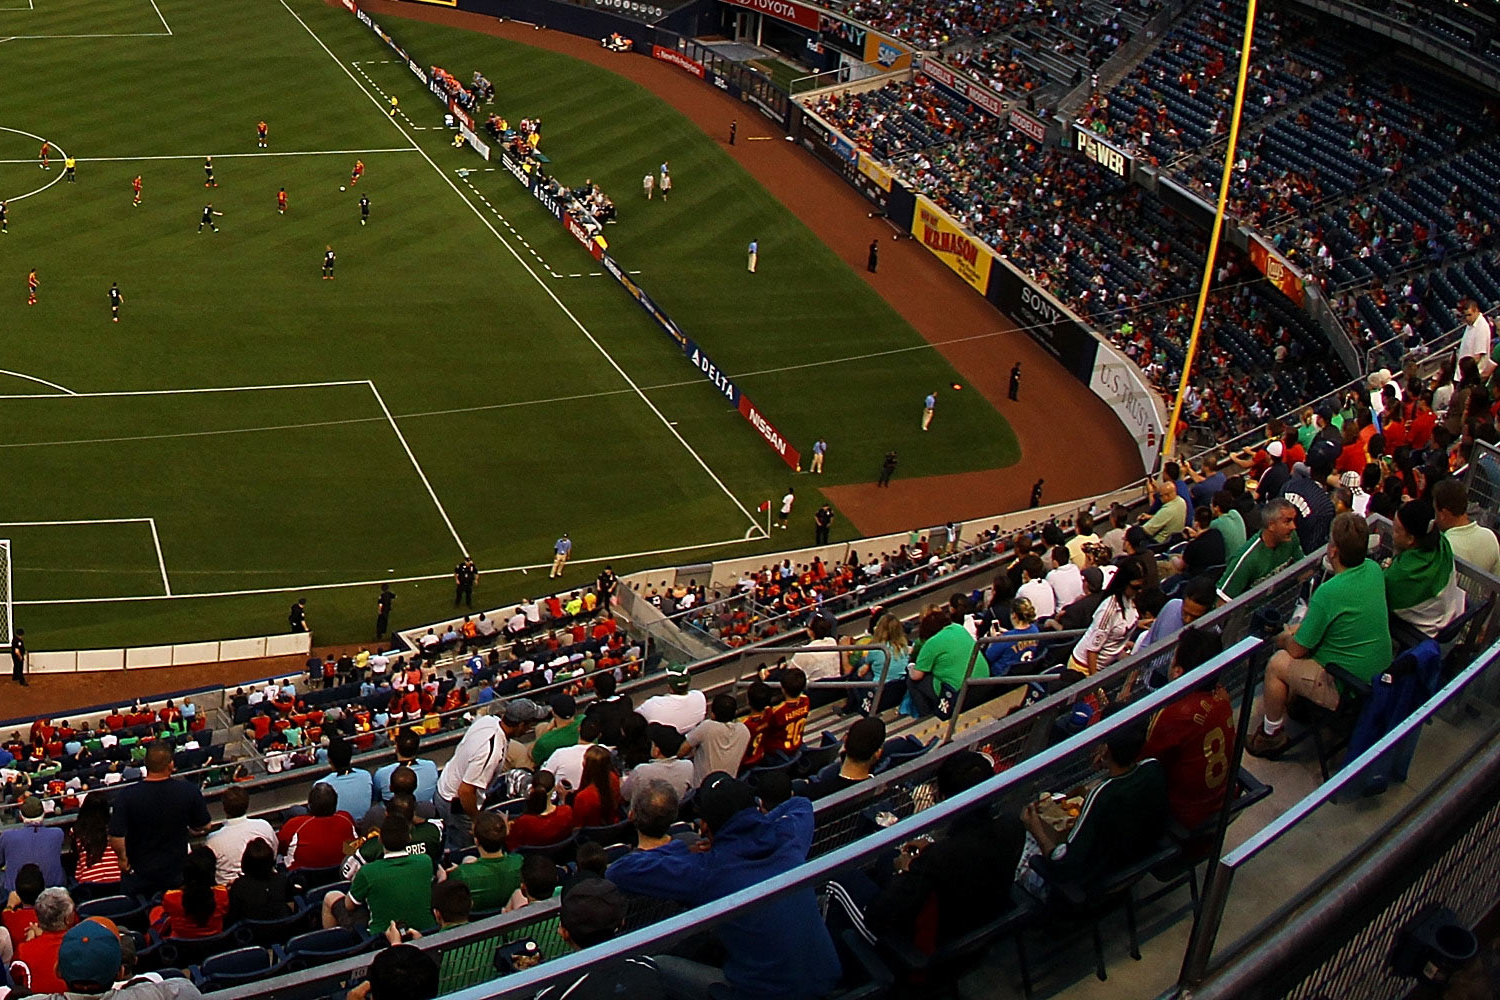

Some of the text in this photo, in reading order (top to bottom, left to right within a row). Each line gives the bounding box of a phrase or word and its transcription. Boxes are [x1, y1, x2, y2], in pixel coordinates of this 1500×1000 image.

[540, 189, 560, 219] DELTA
[1021, 287, 1061, 326] SONY
[701, 357, 733, 400] DELTA
[1121, 384, 1149, 431] TRUST
[749, 408, 787, 455] NISSAN
[1285, 492, 1311, 518] VENDOR
[784, 717, 807, 749] 10
[1203, 727, 1229, 789] 8
